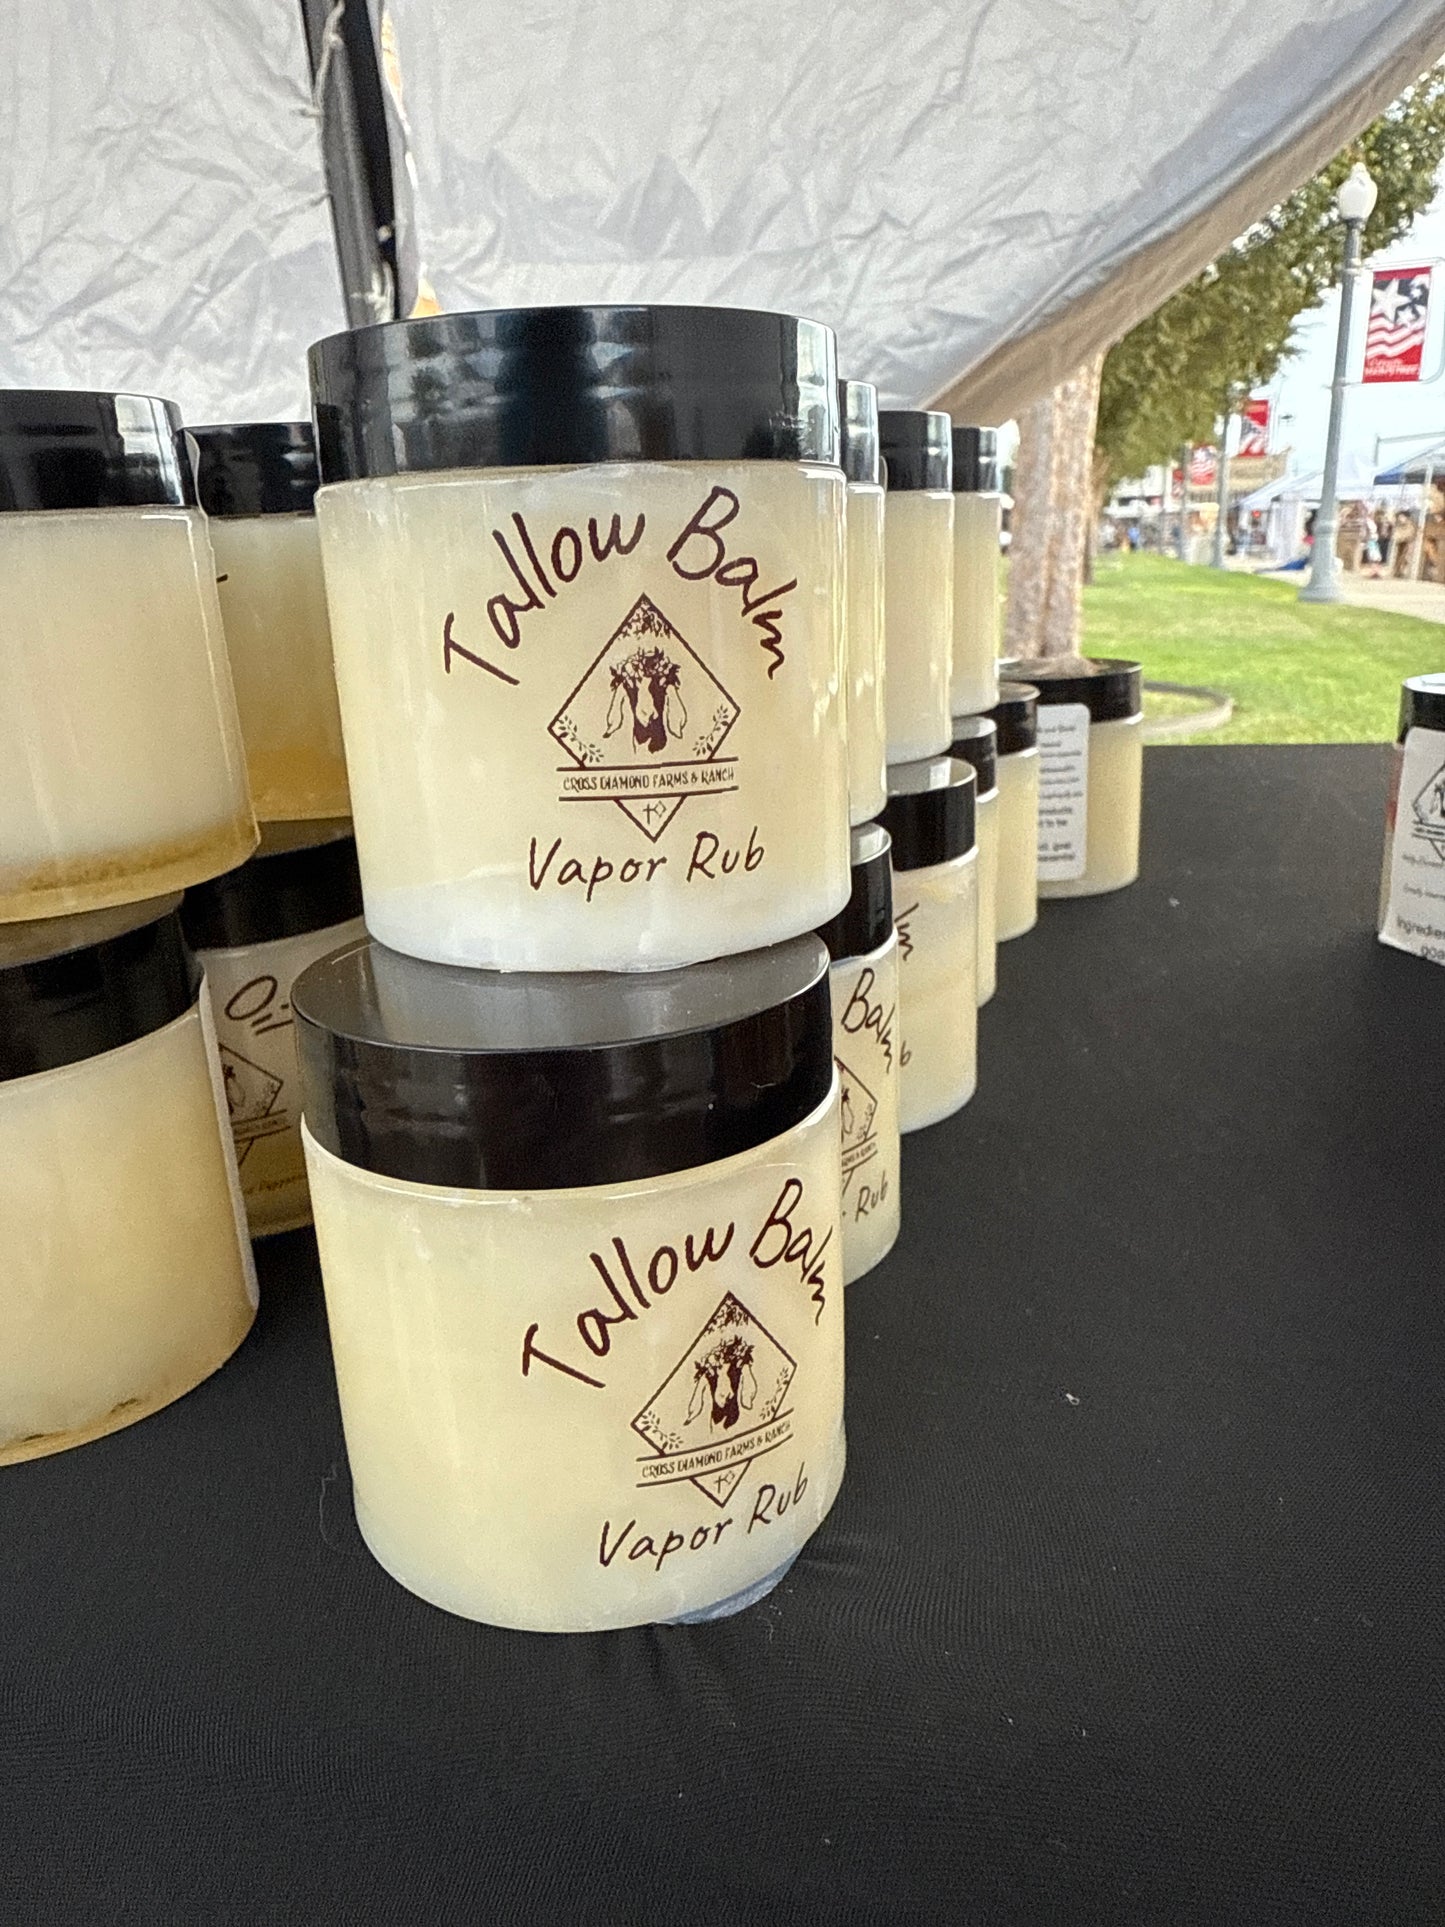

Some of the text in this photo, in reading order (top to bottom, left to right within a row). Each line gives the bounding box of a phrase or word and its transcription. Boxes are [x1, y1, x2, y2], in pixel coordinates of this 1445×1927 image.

[442, 485, 798, 686] Tallow Balm
[563, 766, 735, 793] CROSS DIAMOND FARMS & RANCH
[529, 826, 765, 903] Vapor Rub
[224, 974, 294, 1036] Oil
[842, 967, 894, 1073] Balm
[855, 1169, 888, 1223] Rub
[521, 1177, 834, 1389] Tallow Balm
[642, 1463, 675, 1478] CROSS
[677, 1451, 723, 1472] DIAMOND
[724, 1440, 756, 1460] FARMS
[599, 1461, 809, 1571] Vapor Rub
